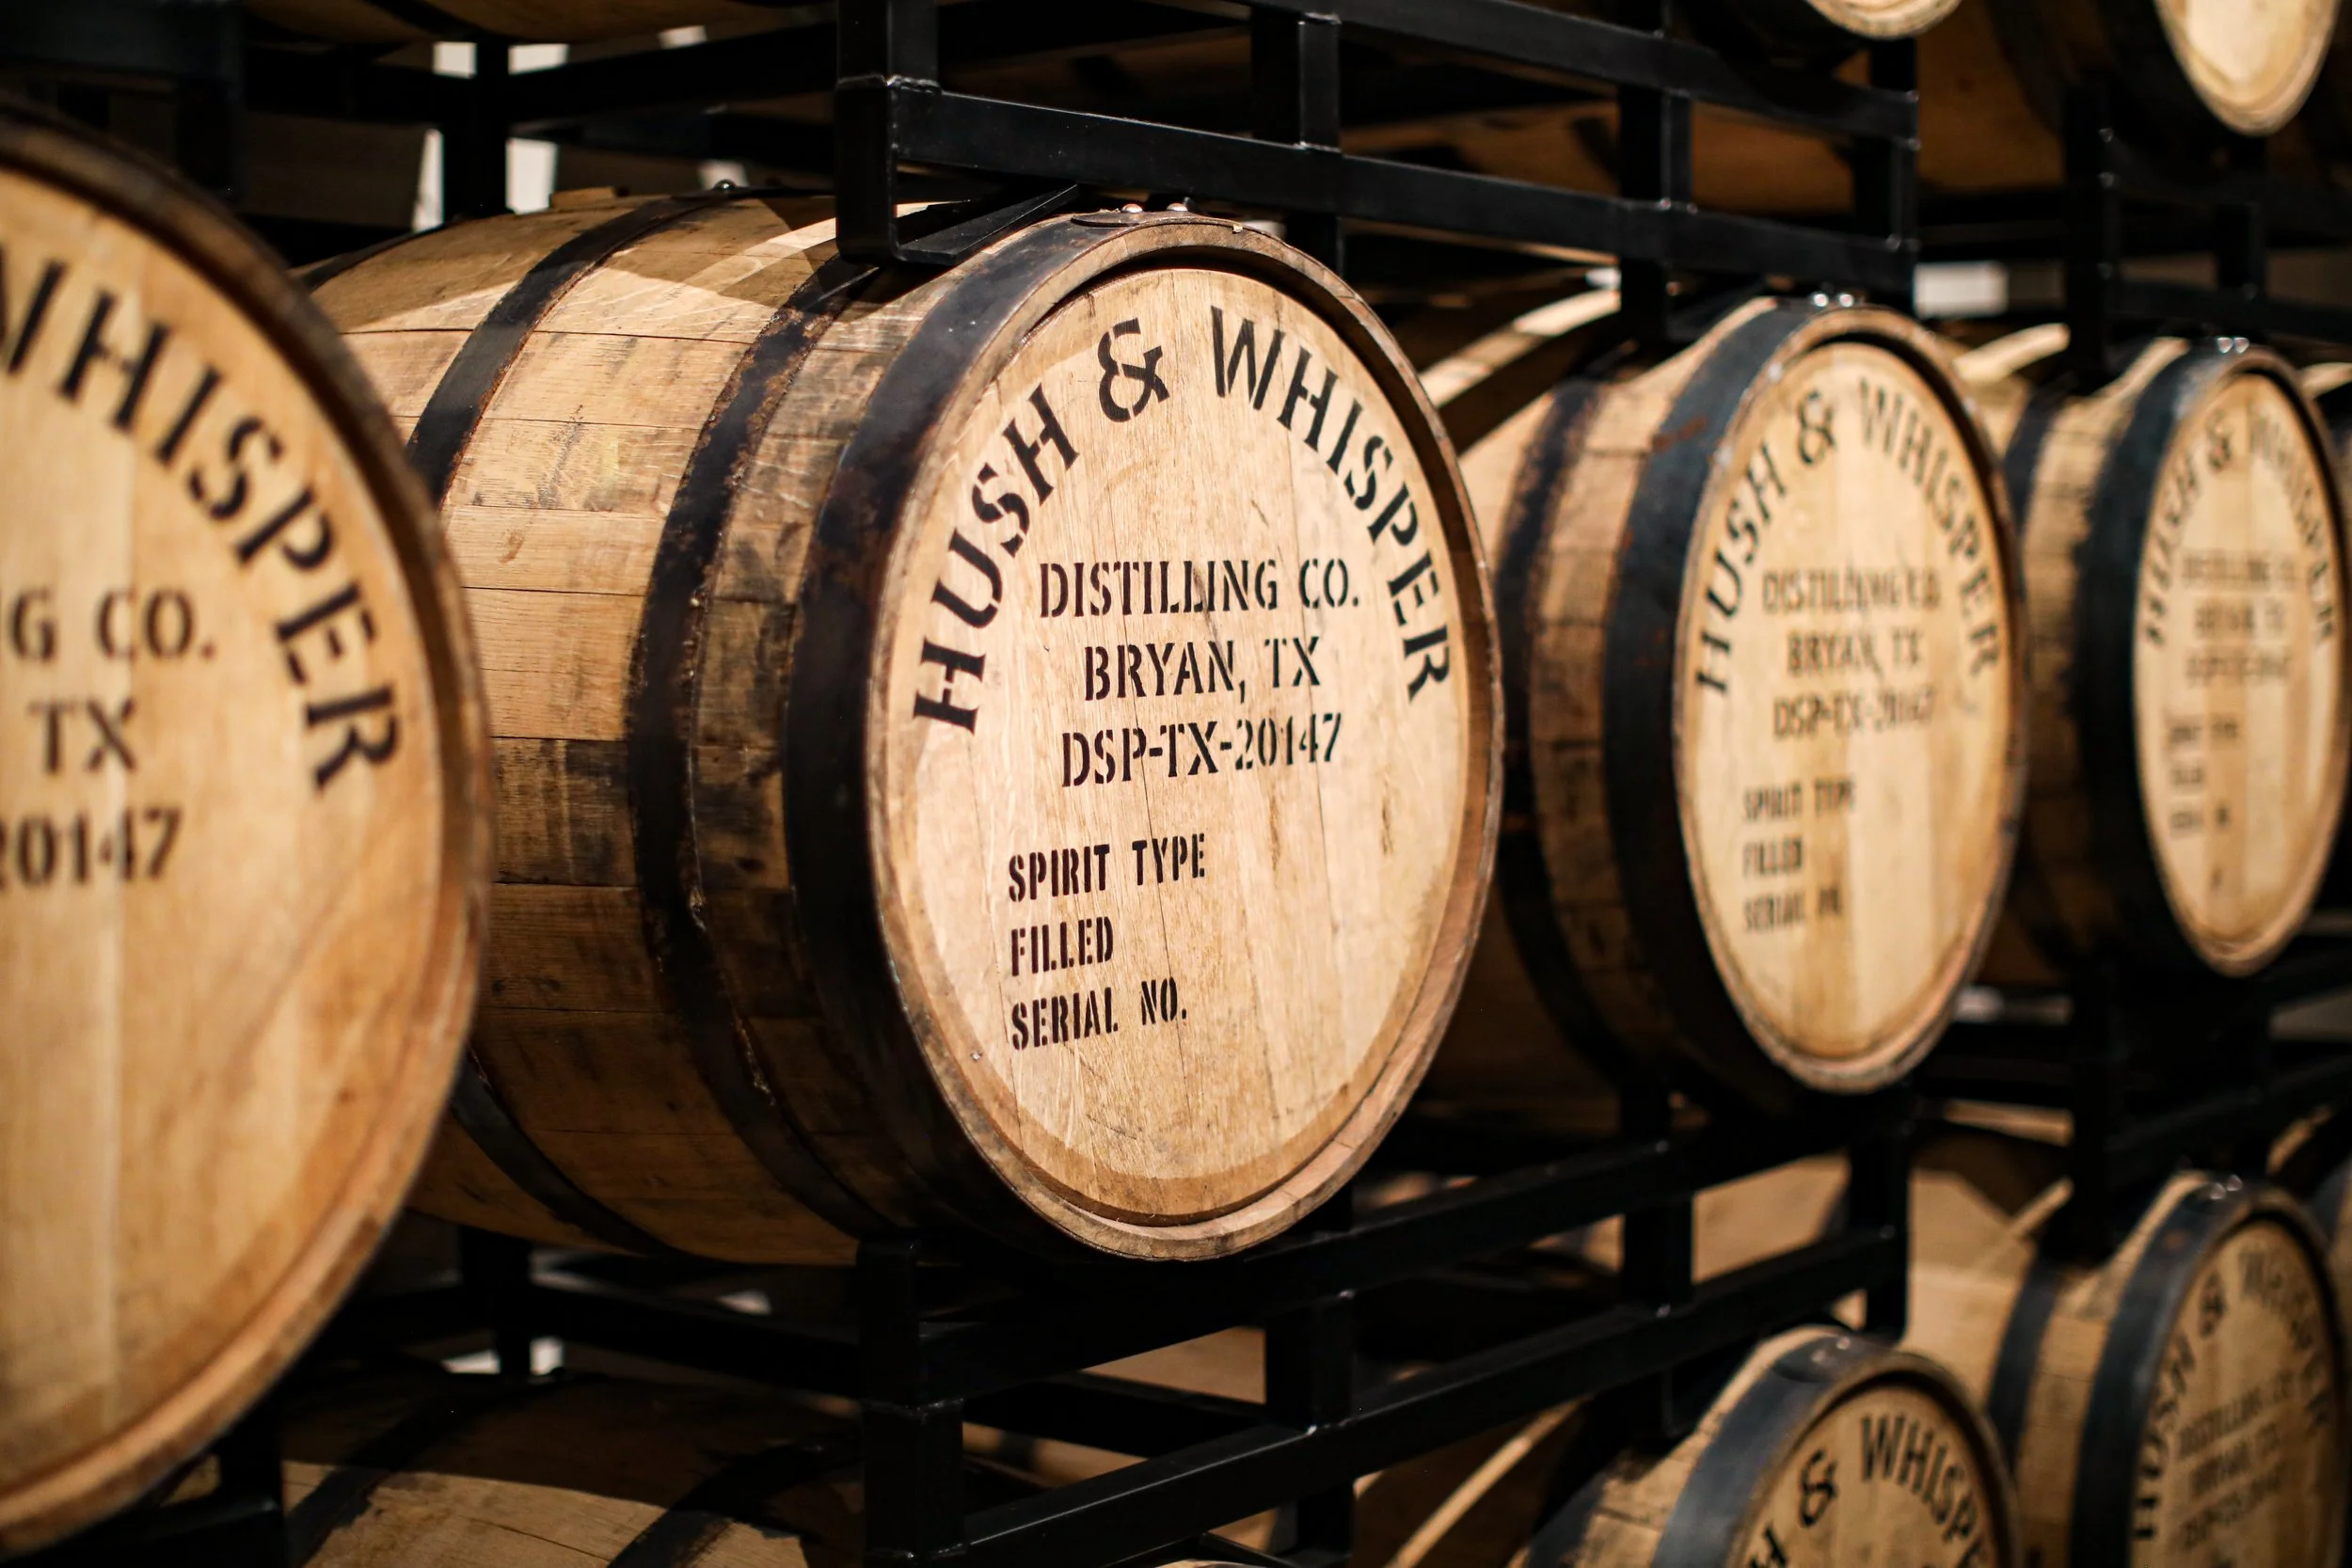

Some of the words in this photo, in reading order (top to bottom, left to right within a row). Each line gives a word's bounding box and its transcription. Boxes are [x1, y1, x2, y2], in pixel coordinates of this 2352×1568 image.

[913, 382, 1080, 736] HUSH
[1098, 317, 1169, 423] &
[1210, 306, 1451, 704] WHISPER
[1040, 559, 1279, 619] DISTILLING
[1298, 558, 1360, 609] CO.
[1693, 440, 1787, 698] HUSH
[93, 585, 217, 664] CO.
[1084, 640, 1247, 705] BRYAN,
[1263, 636, 1321, 689] TX
[26, 696, 138, 775] TX
[1061, 712, 1343, 788] DSP-TX-20147
[1009, 842, 1111, 903] SPIRIT
[1132, 832, 1206, 887] TYPE
[1010, 915, 1114, 977] FILLED
[1011, 986, 1119, 1052] SERIAL
[1140, 976, 1188, 1026] NO.
[1799, 1450, 1836, 1528] &
[1860, 1413, 1985, 1568] WHISP
